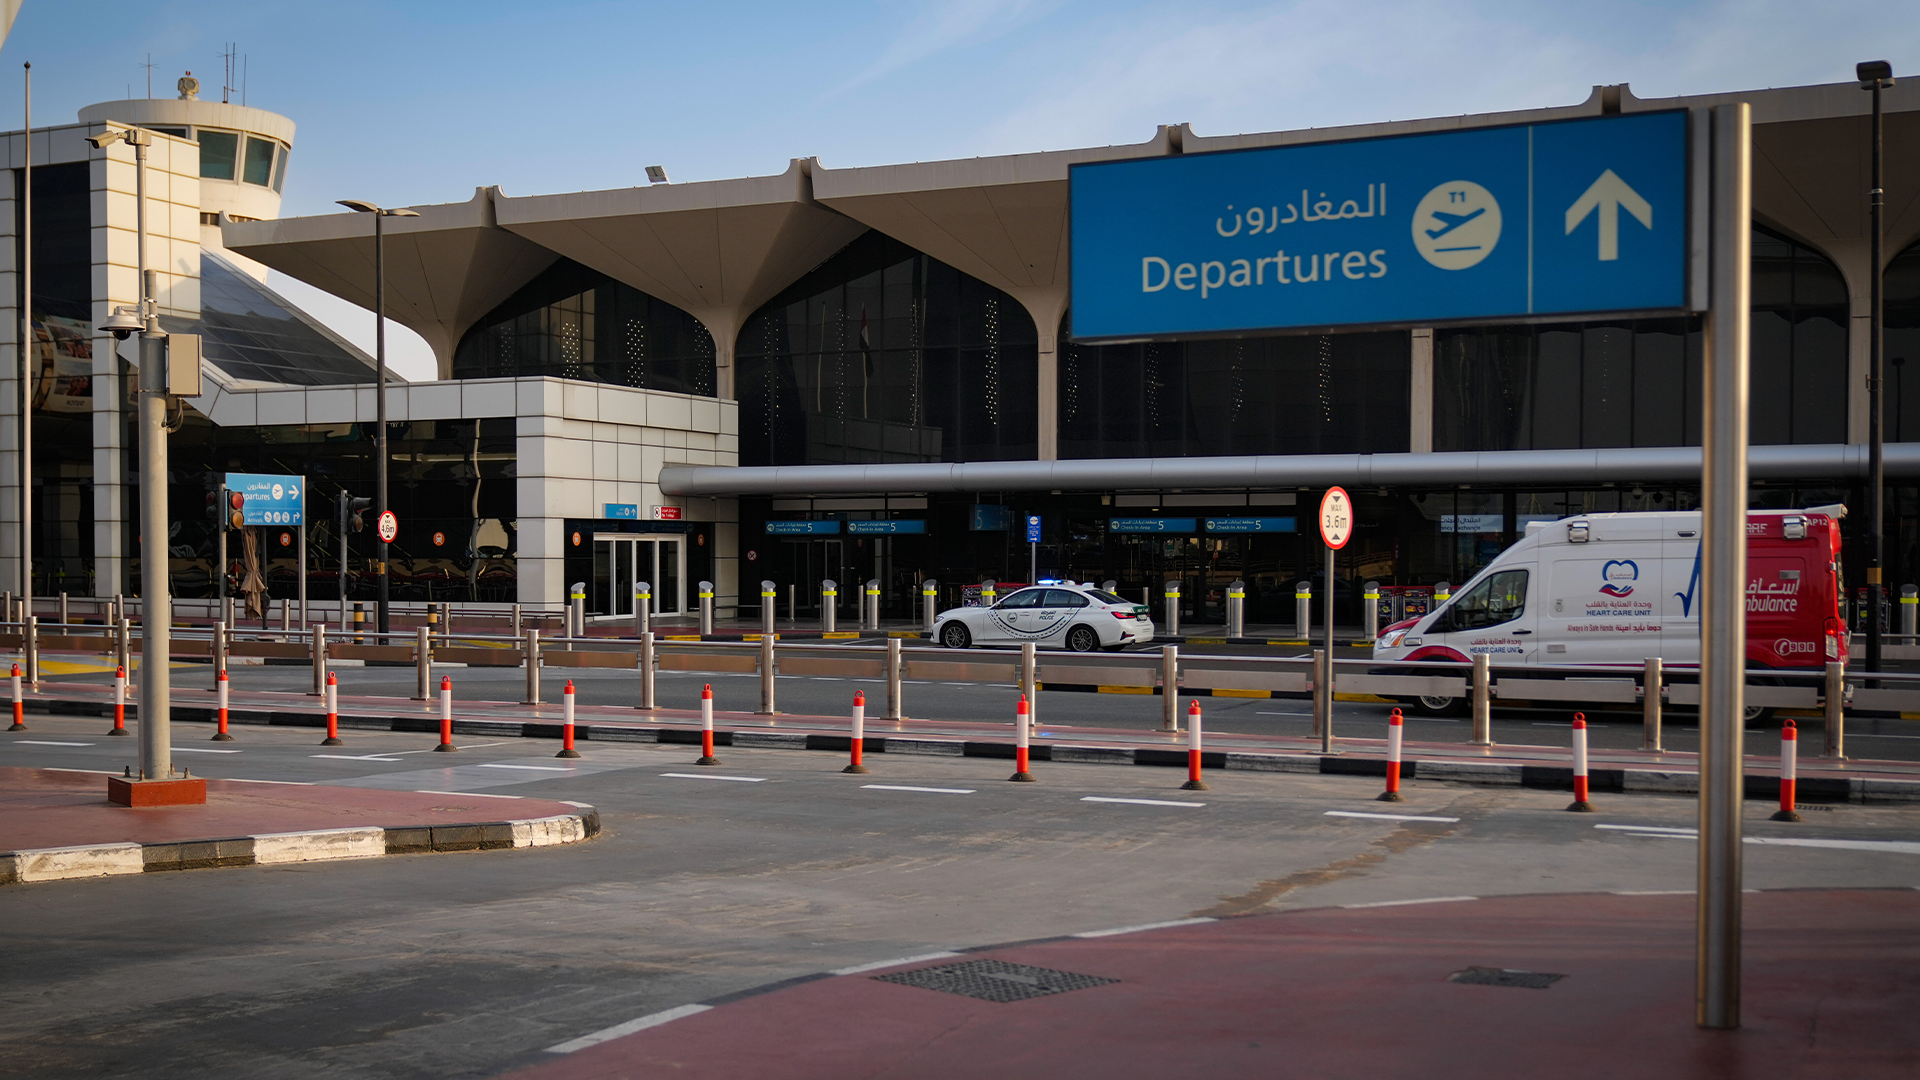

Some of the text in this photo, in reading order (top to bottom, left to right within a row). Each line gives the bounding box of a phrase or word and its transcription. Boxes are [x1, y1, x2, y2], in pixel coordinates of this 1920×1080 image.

[1448, 191, 1466, 203] T1
[1215, 182, 1387, 238] المغادرون
[1142, 249, 1388, 299] Departures
[243, 493, 271, 502] epartures
[1331, 504, 1342, 512] MAX
[977, 510, 983, 529] 5
[1325, 514, 1347, 529] 3.6m
[1806, 518, 1828, 526] AP12
[381, 524, 395, 533] 4.6m
[807, 523, 813, 532] 5
[890, 522, 896, 532] 5
[1158, 520, 1164, 530] 5
[1255, 520, 1262, 530] 5
[1585, 600, 1652, 609] وحدة العناية بالقلب
[1745, 595, 1797, 612] bulance
[1567, 624, 1584, 633] Always
[1589, 624, 1599, 632] Safe
[1600, 624, 1614, 632] Hands
[1790, 642, 1814, 652] 998
